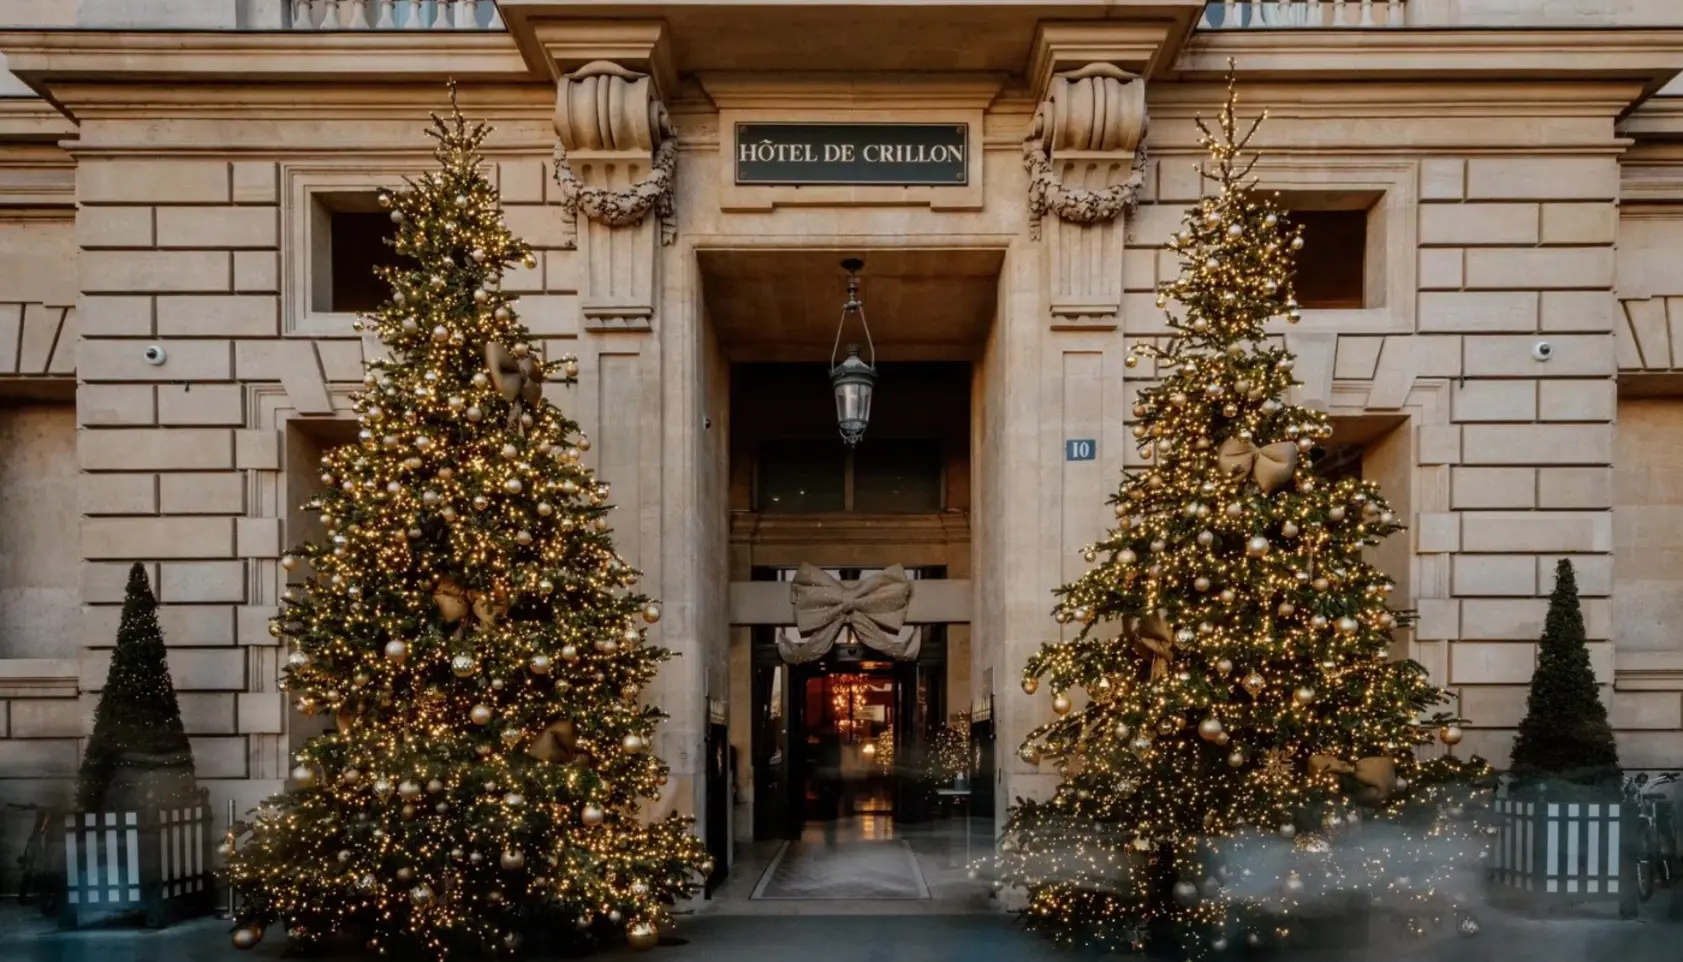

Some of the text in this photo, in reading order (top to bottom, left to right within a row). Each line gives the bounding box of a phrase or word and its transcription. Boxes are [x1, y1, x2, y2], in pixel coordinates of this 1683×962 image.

[739, 139, 964, 163] HÔTEL DE CRILLON
[1072, 441, 1090, 458] 10
